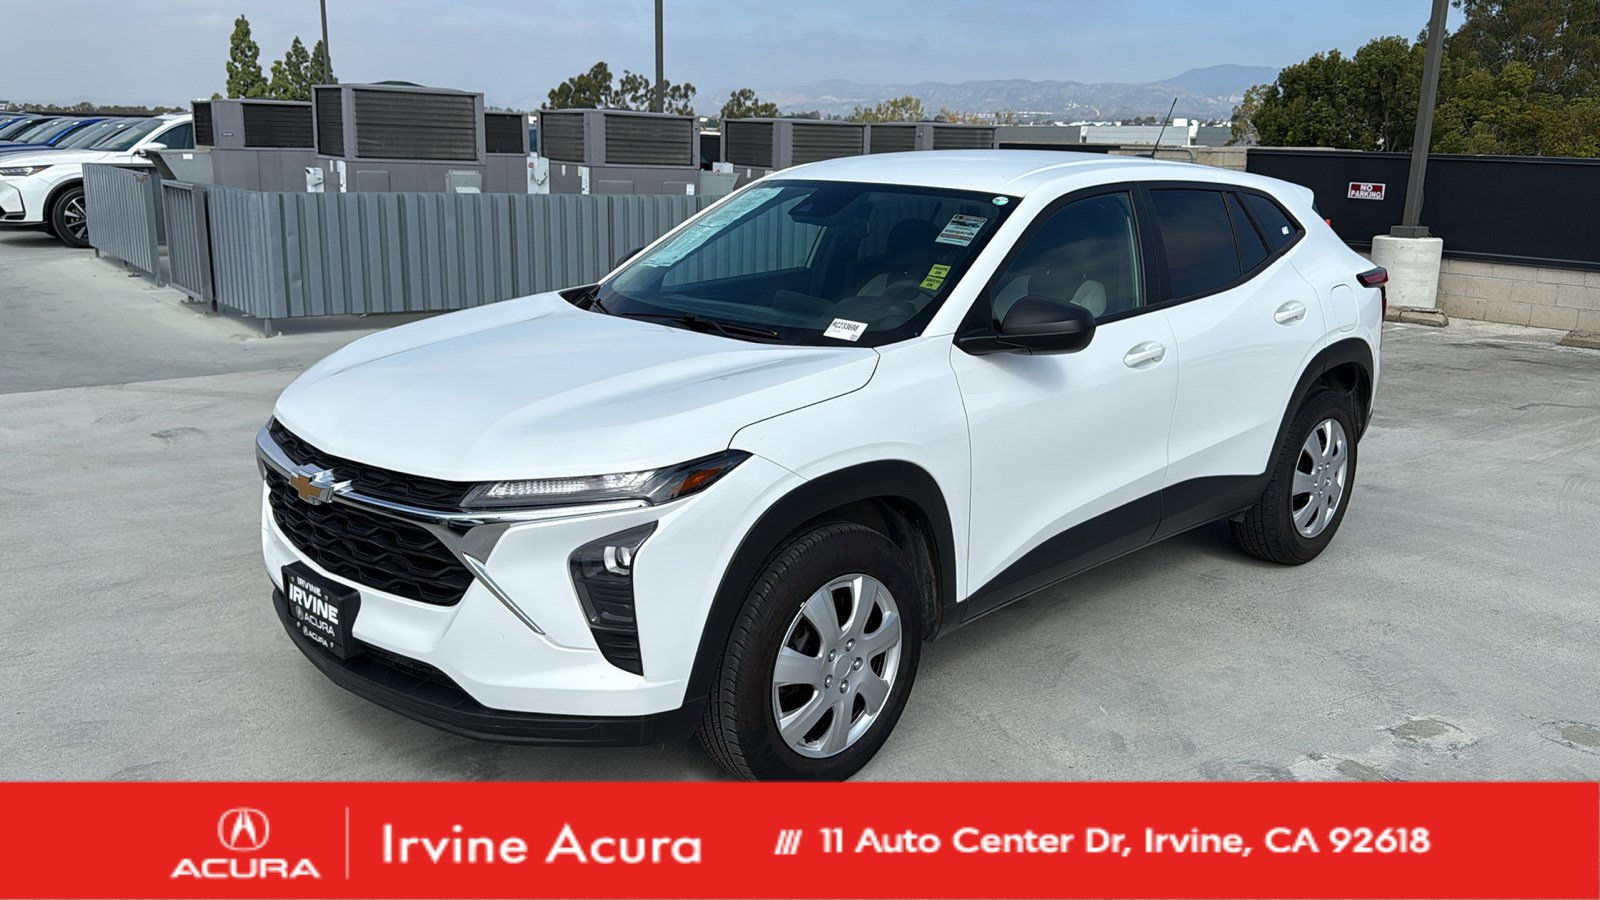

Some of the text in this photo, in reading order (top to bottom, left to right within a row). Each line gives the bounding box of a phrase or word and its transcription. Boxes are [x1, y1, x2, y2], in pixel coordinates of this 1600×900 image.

[1350, 190, 1382, 199] PARKING
[1360, 184, 1373, 192] NO
[296, 576, 322, 596] IRVINE
[289, 583, 339, 625] IRVINE
[304, 612, 335, 637] ACURA
[308, 630, 329, 648] ACURA
